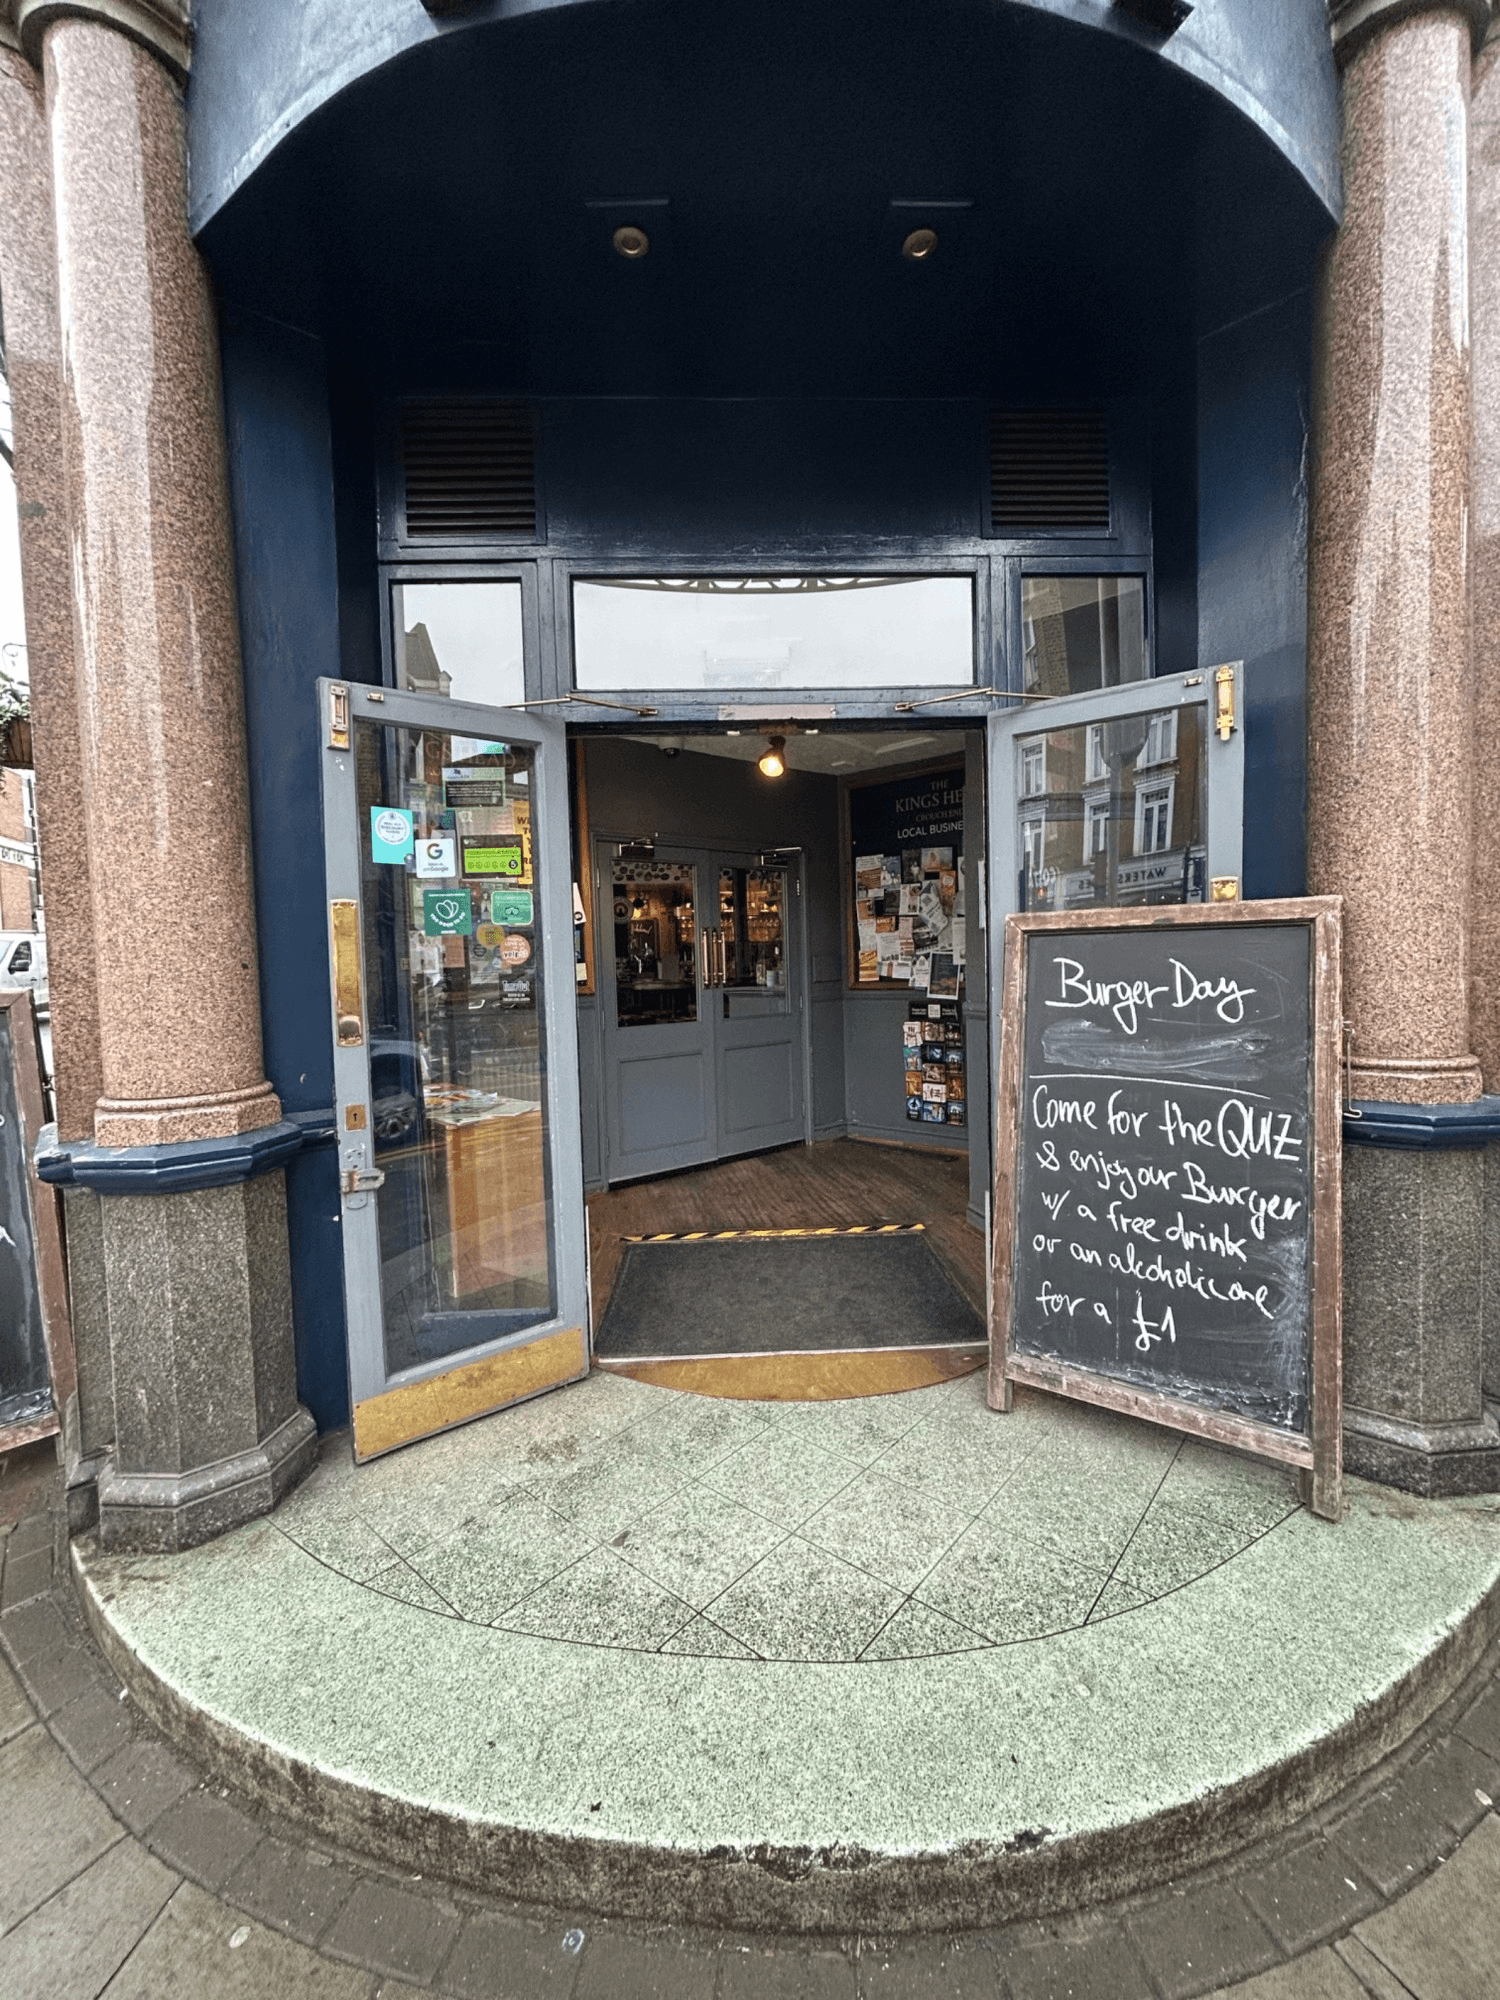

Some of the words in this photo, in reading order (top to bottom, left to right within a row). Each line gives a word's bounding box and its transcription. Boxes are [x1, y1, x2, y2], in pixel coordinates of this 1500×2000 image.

[895, 792, 940, 813] KINGS
[943, 788, 964, 806] HE
[930, 779, 950, 791] THE
[897, 826, 928, 839] LOCAL
[929, 820, 964, 835] BUSINE
[1045, 957, 1169, 1035] Burger
[1168, 957, 1257, 1024] Day
[1032, 1084, 1098, 1130] Come
[1106, 1088, 1149, 1137] for
[1158, 1099, 1216, 1146] the
[1216, 1098, 1303, 1161] QUIZ
[1036, 1140, 1061, 1172] &
[1069, 1149, 1138, 1200] enjoy
[1137, 1165, 1178, 1191] our
[1181, 1161, 1302, 1241] Burger
[1041, 1189, 1071, 1222] w/
[1076, 1204, 1098, 1222] a
[1106, 1200, 1162, 1243] free
[1164, 1210, 1248, 1263] drink
[1032, 1234, 1063, 1254] or
[1069, 1242, 1103, 1267] an
[1108, 1242, 1230, 1301] alcoholic
[1227, 1281, 1275, 1321] one
[1035, 1280, 1087, 1317] for
[1093, 1302, 1113, 1325] a
[1131, 1292, 1177, 1352] £1
